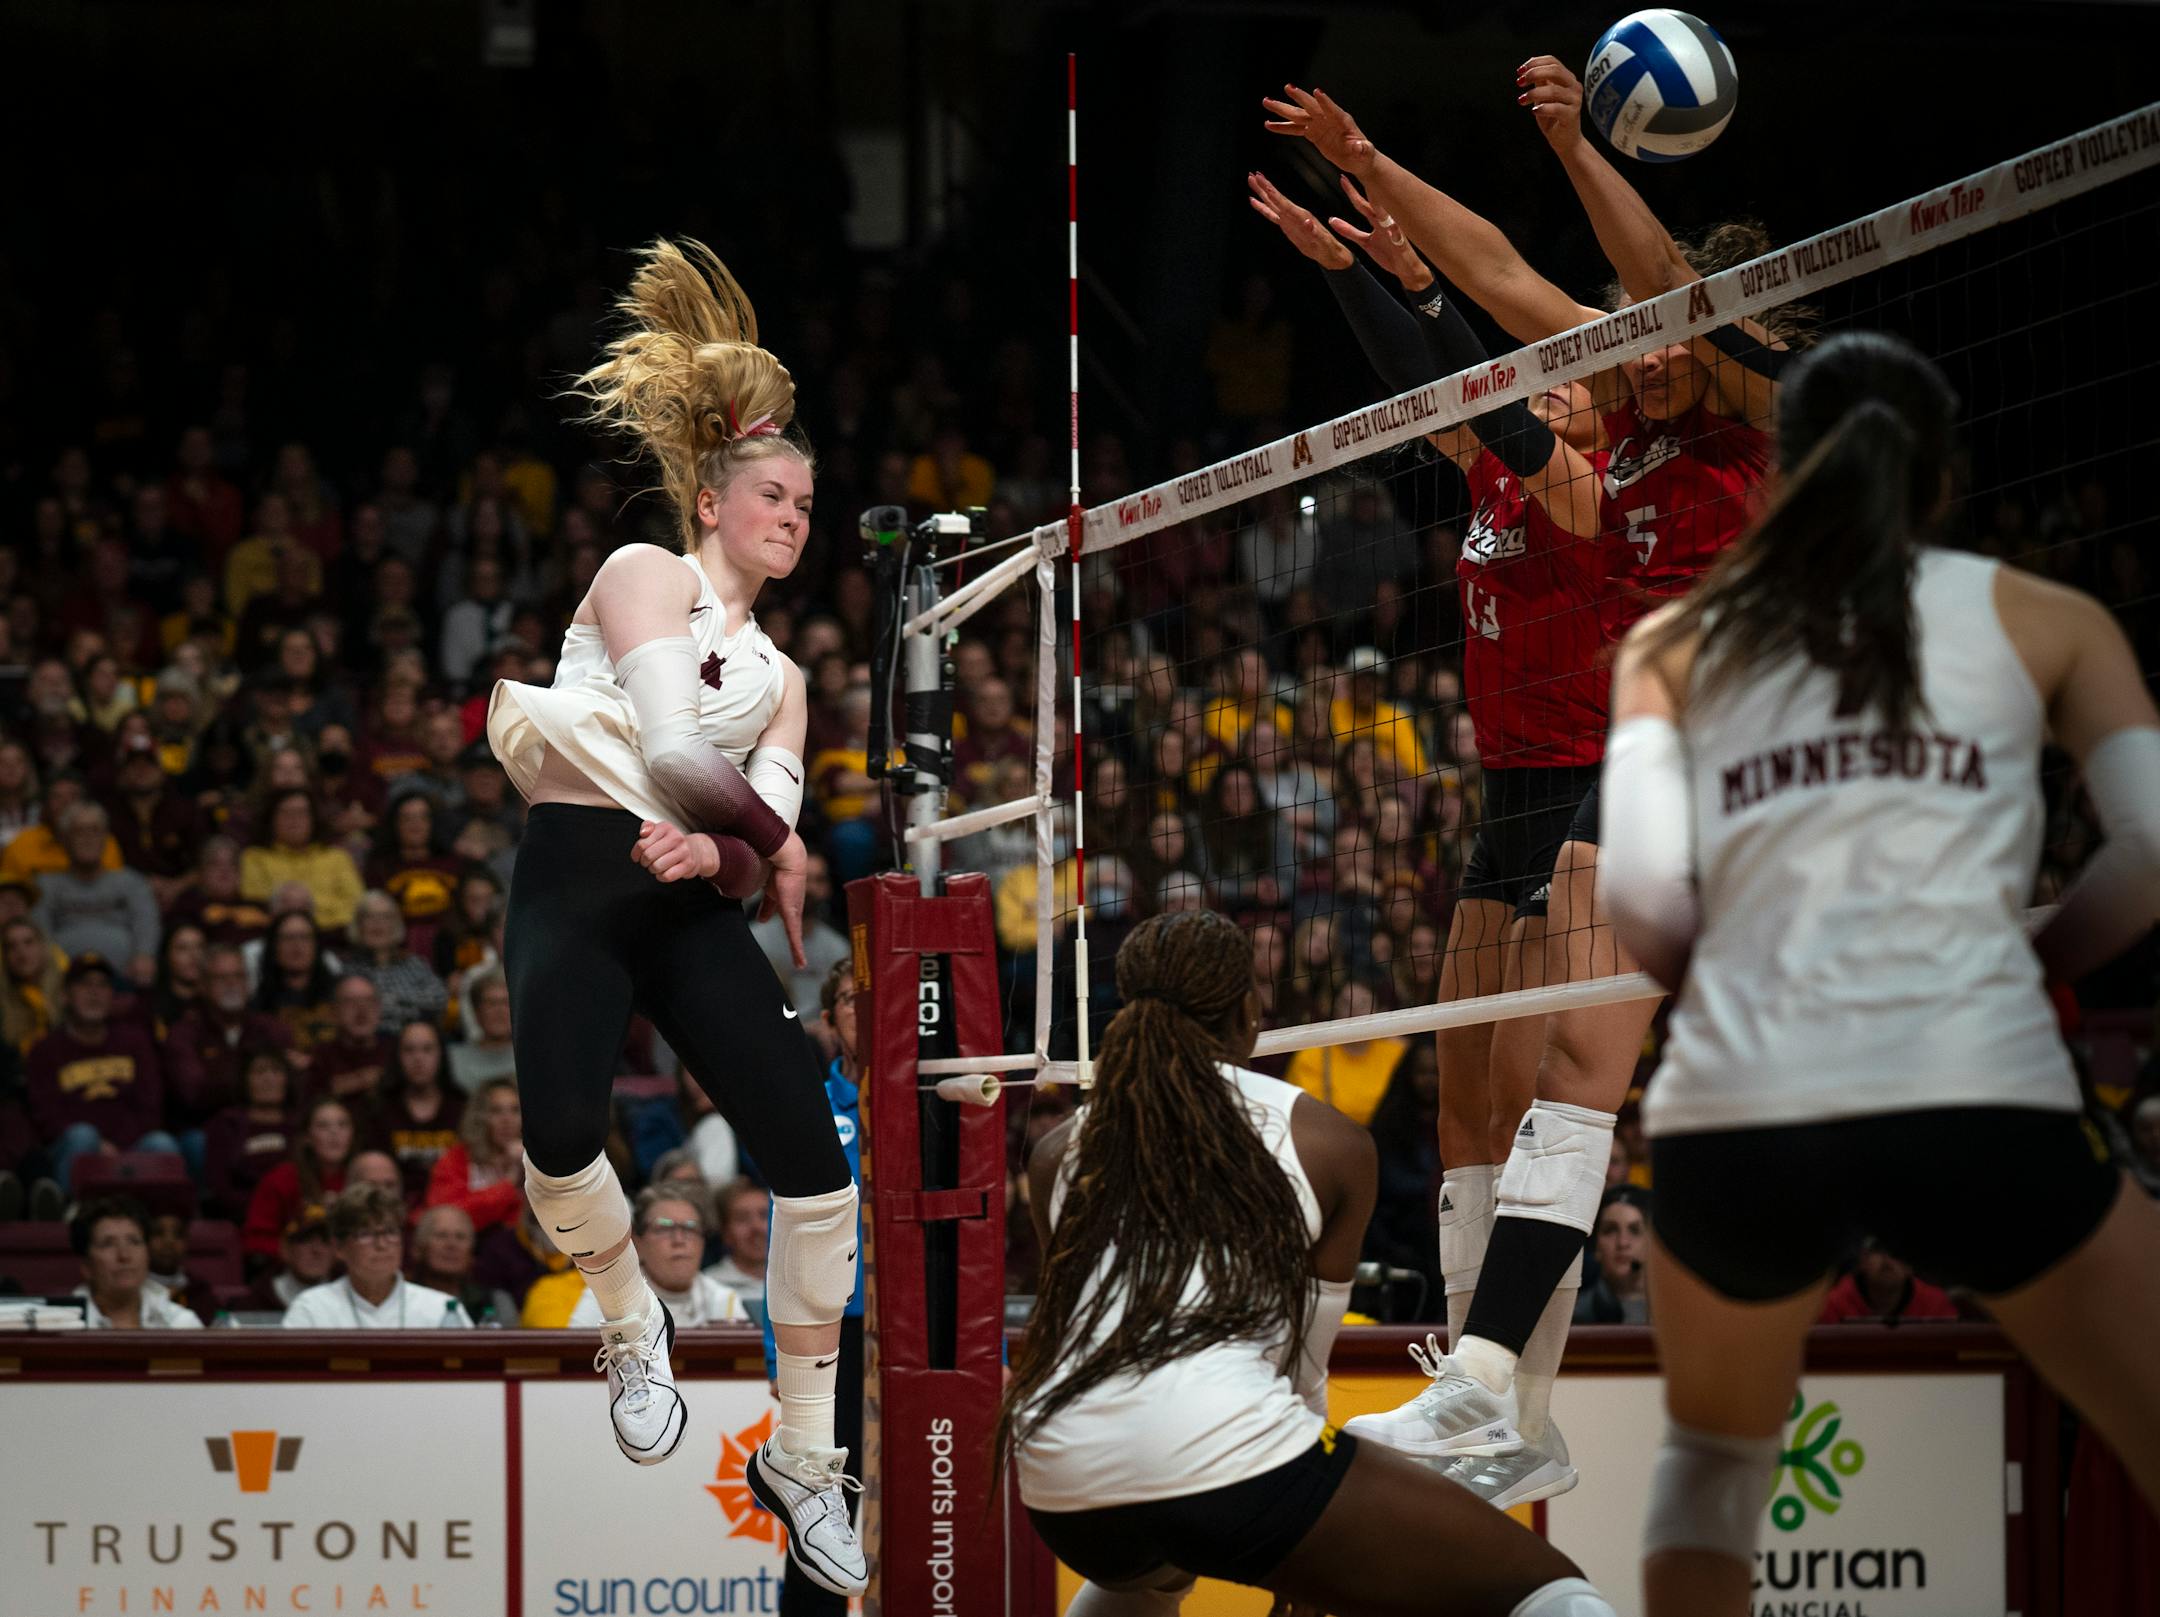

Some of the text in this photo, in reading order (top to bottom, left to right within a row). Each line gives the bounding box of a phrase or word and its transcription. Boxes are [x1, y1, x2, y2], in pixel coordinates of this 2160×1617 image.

[2013, 106, 2160, 194] GOPHER VOLLEYBA
[1740, 219, 1882, 298] GOPHER VOLLEYBALL
[1538, 303, 1663, 374] GOPHER VOLLEYBALL
[1333, 388, 1439, 450] GOPHER VOLLEYBALL
[1177, 449, 1274, 505] GOPHER VOLLEYBALL
[1624, 504, 1658, 566] 5
[1720, 732, 1989, 817] MINNESOTA
[926, 1417, 957, 1515] sports
[34, 1518, 474, 1566] TRUSTONE
[78, 1583, 430, 1613] FINANCIAL
[554, 1578, 636, 1617] sun
